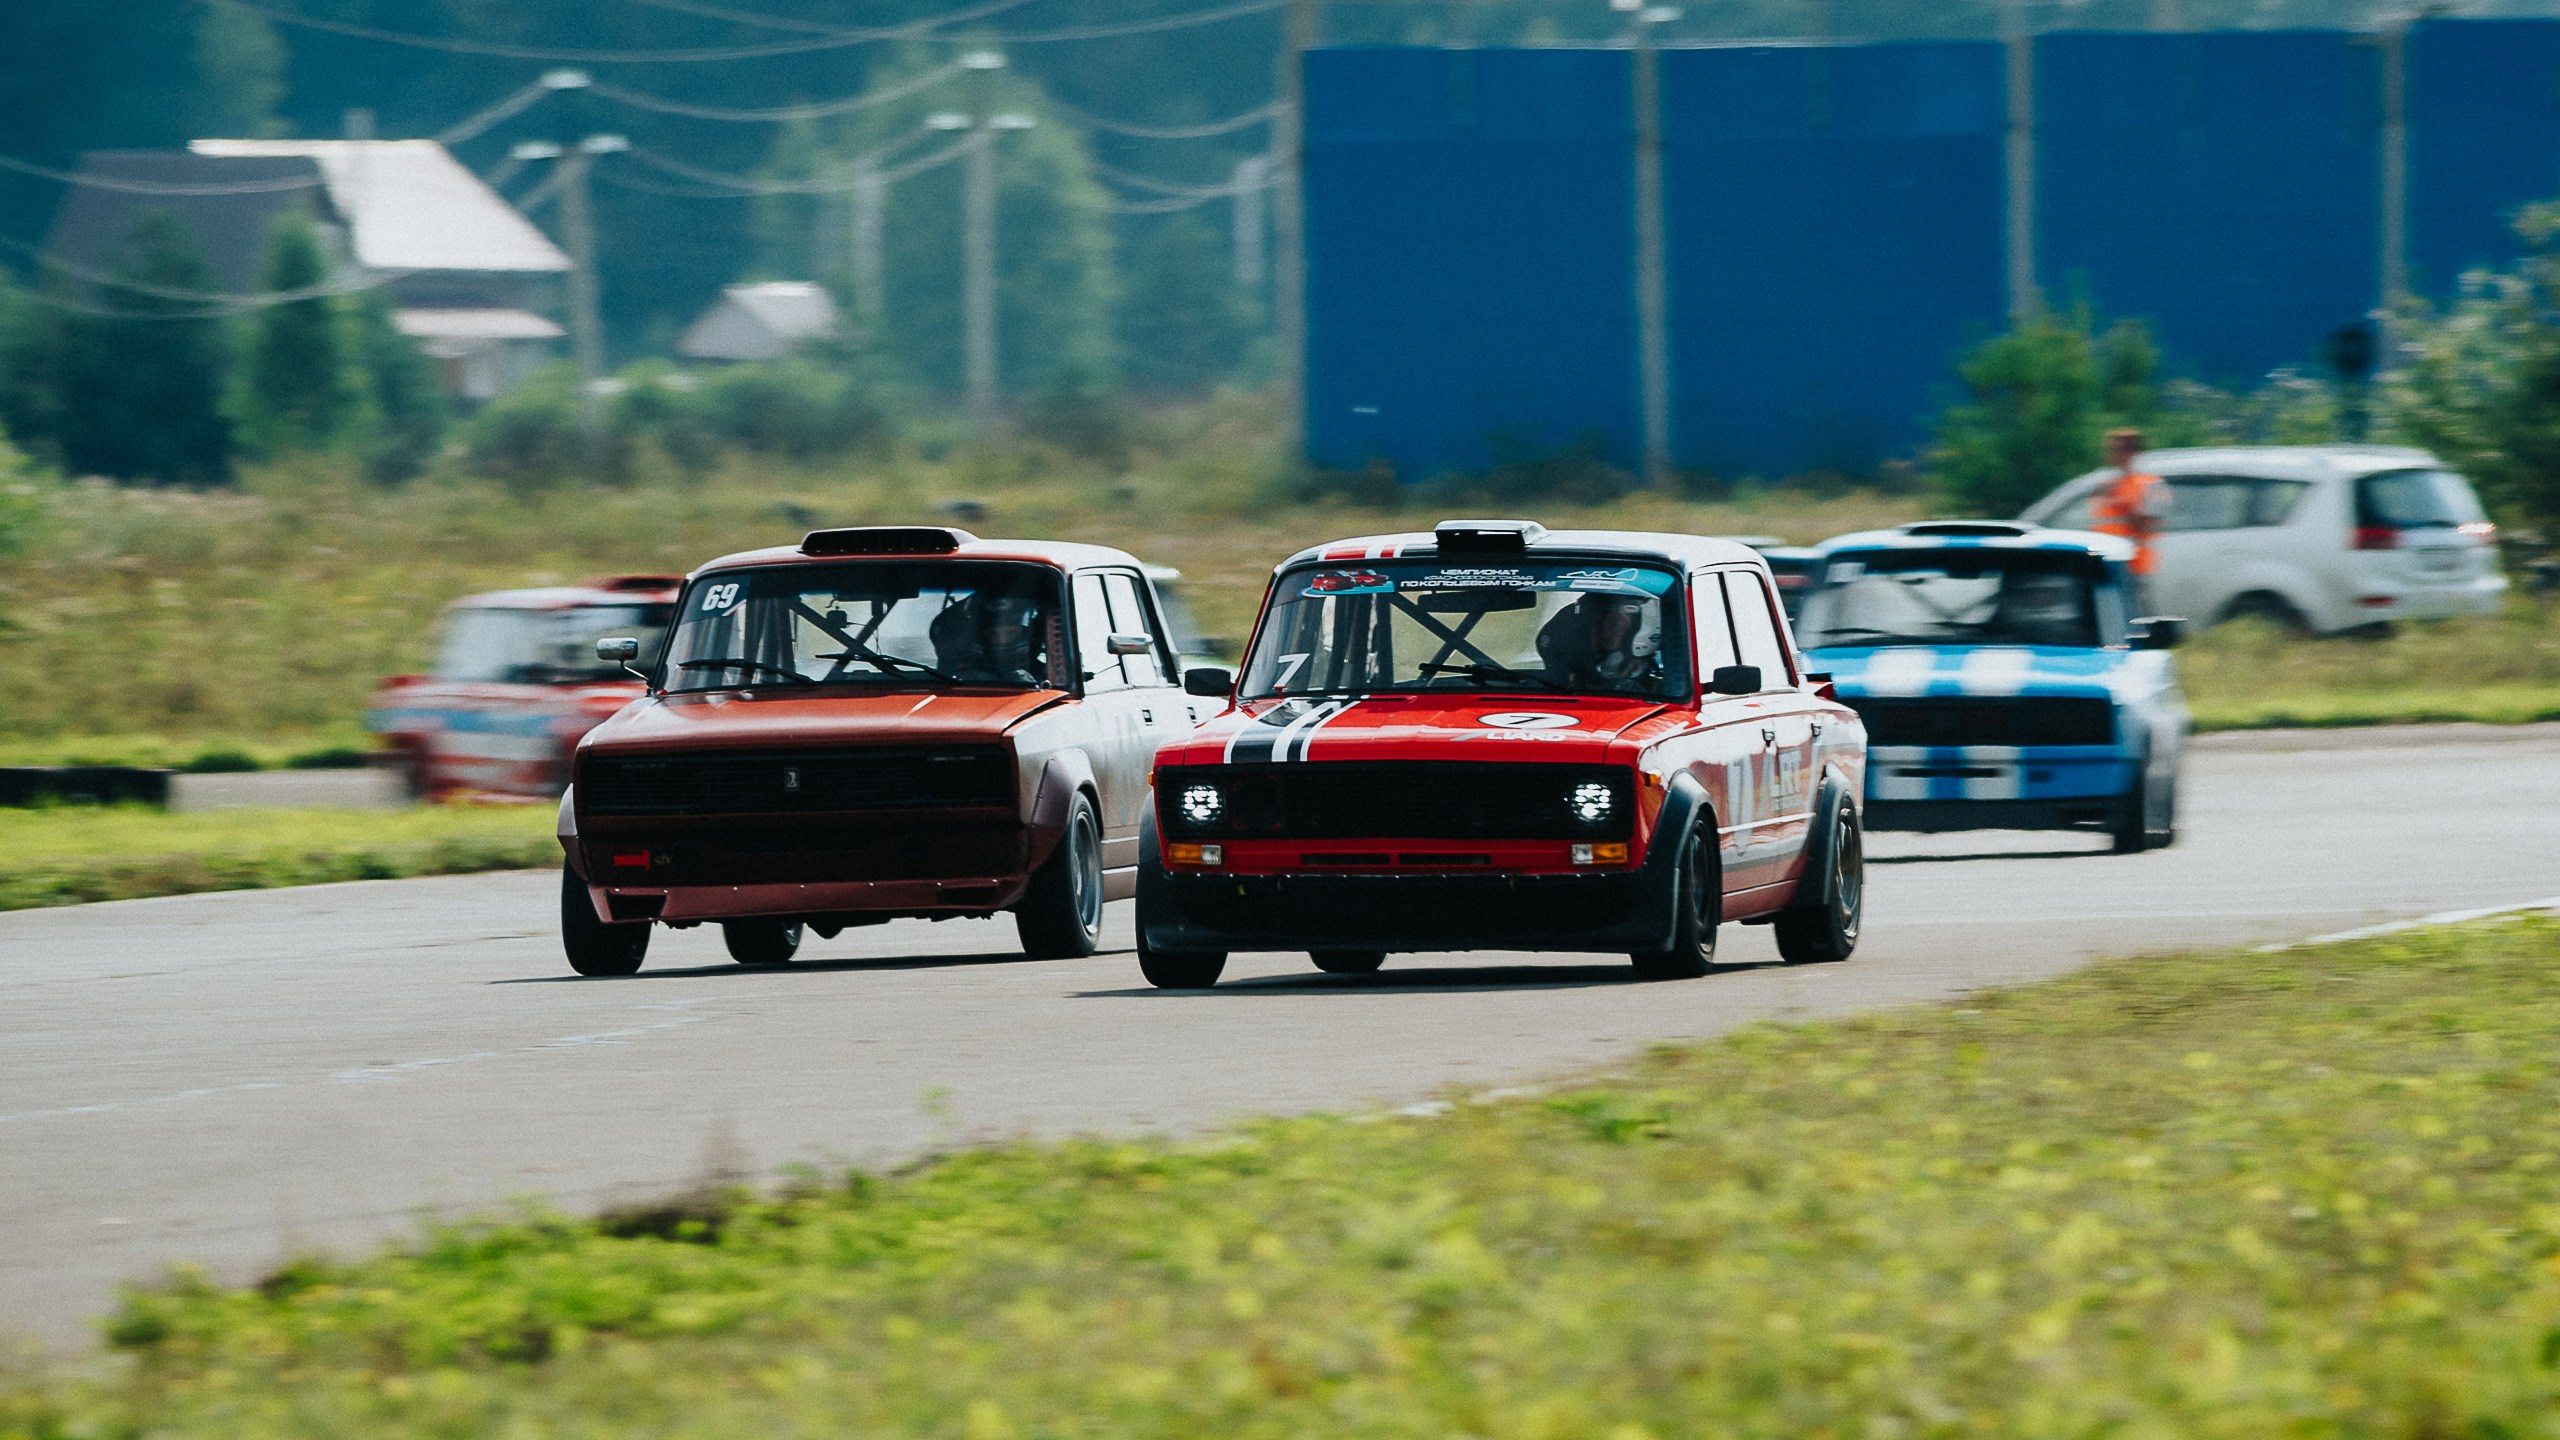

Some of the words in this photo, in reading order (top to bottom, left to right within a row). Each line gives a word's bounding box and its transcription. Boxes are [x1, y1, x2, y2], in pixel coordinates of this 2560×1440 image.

[1440, 568, 1520, 576] ЧЕМПИОНАТ
[1400, 580, 1419, 588] ПО
[1501, 580, 1557, 588] ГОНКАМ
[701, 583, 739, 612] 69
[1267, 653, 1310, 688] 7
[1508, 714, 1550, 725] 7
